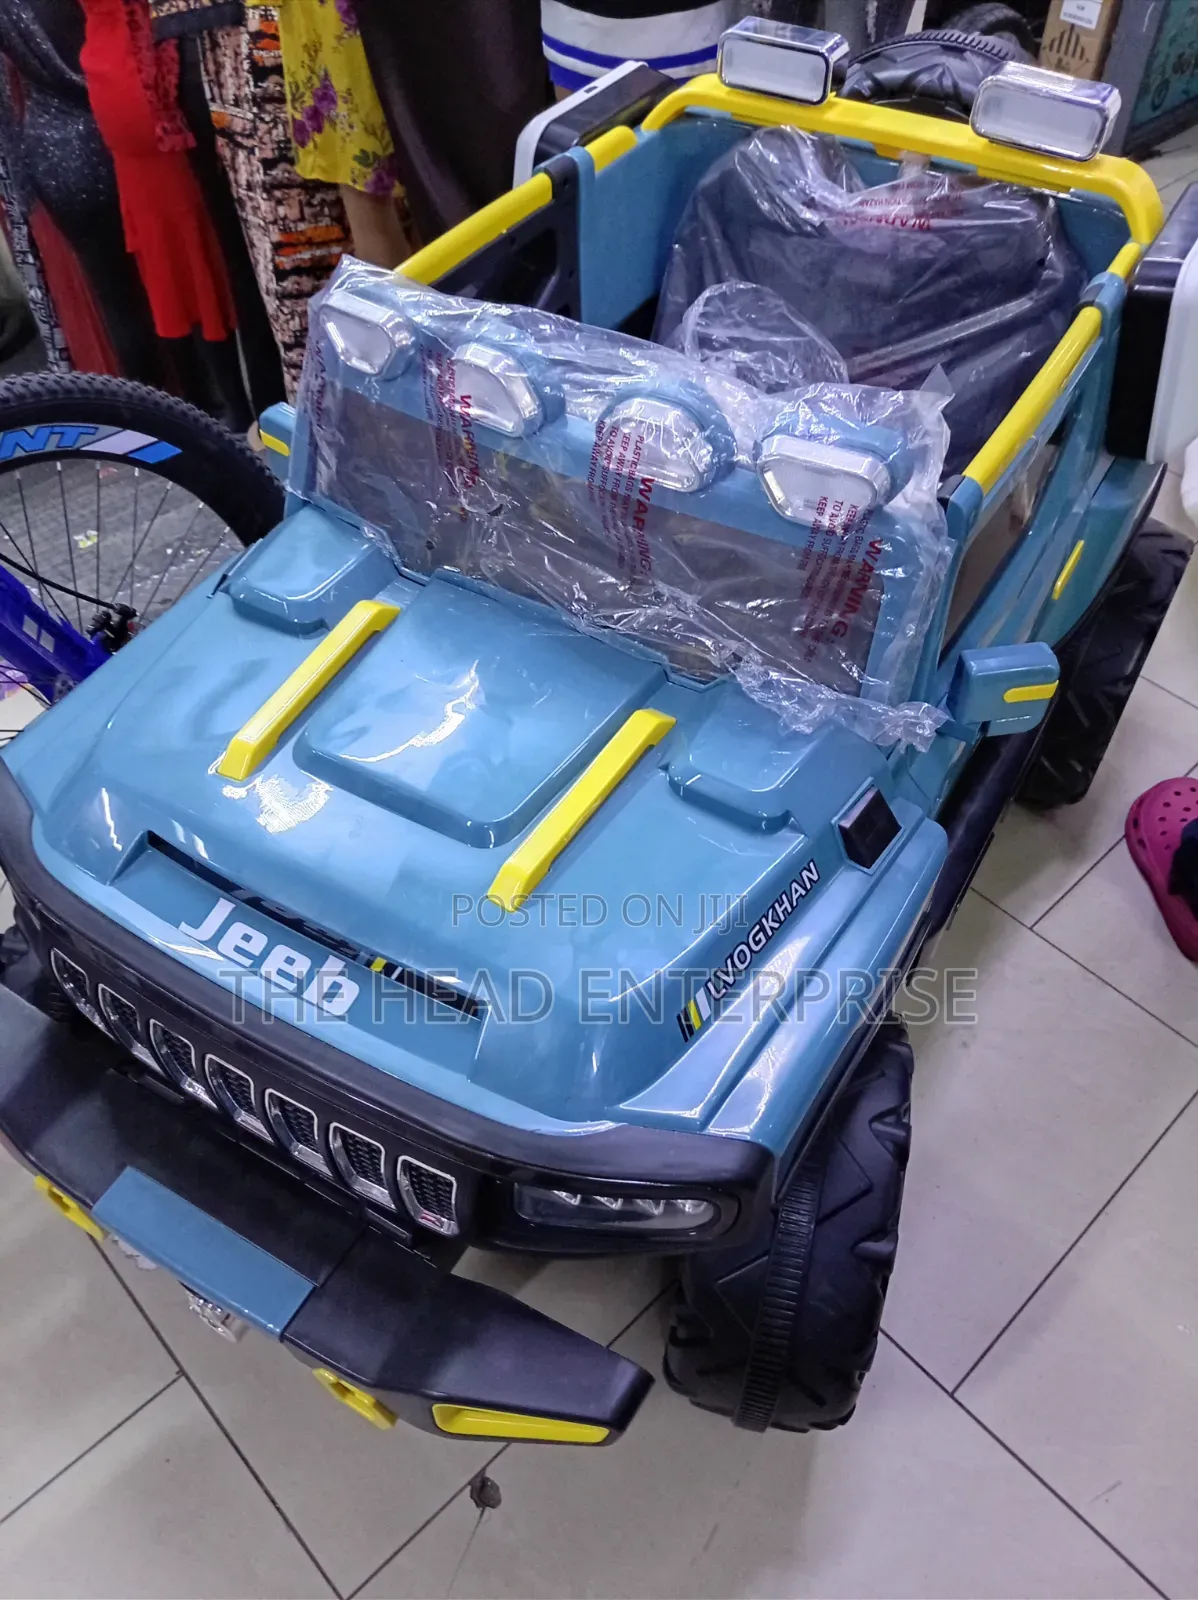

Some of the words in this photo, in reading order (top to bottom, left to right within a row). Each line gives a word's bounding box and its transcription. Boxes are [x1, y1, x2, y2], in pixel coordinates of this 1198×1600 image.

[814, 495, 829, 517] KEEP
[831, 499, 844, 513] TO
[178, 897, 360, 1017] Jeeb
[704, 858, 820, 1002] LVOGKHAN
